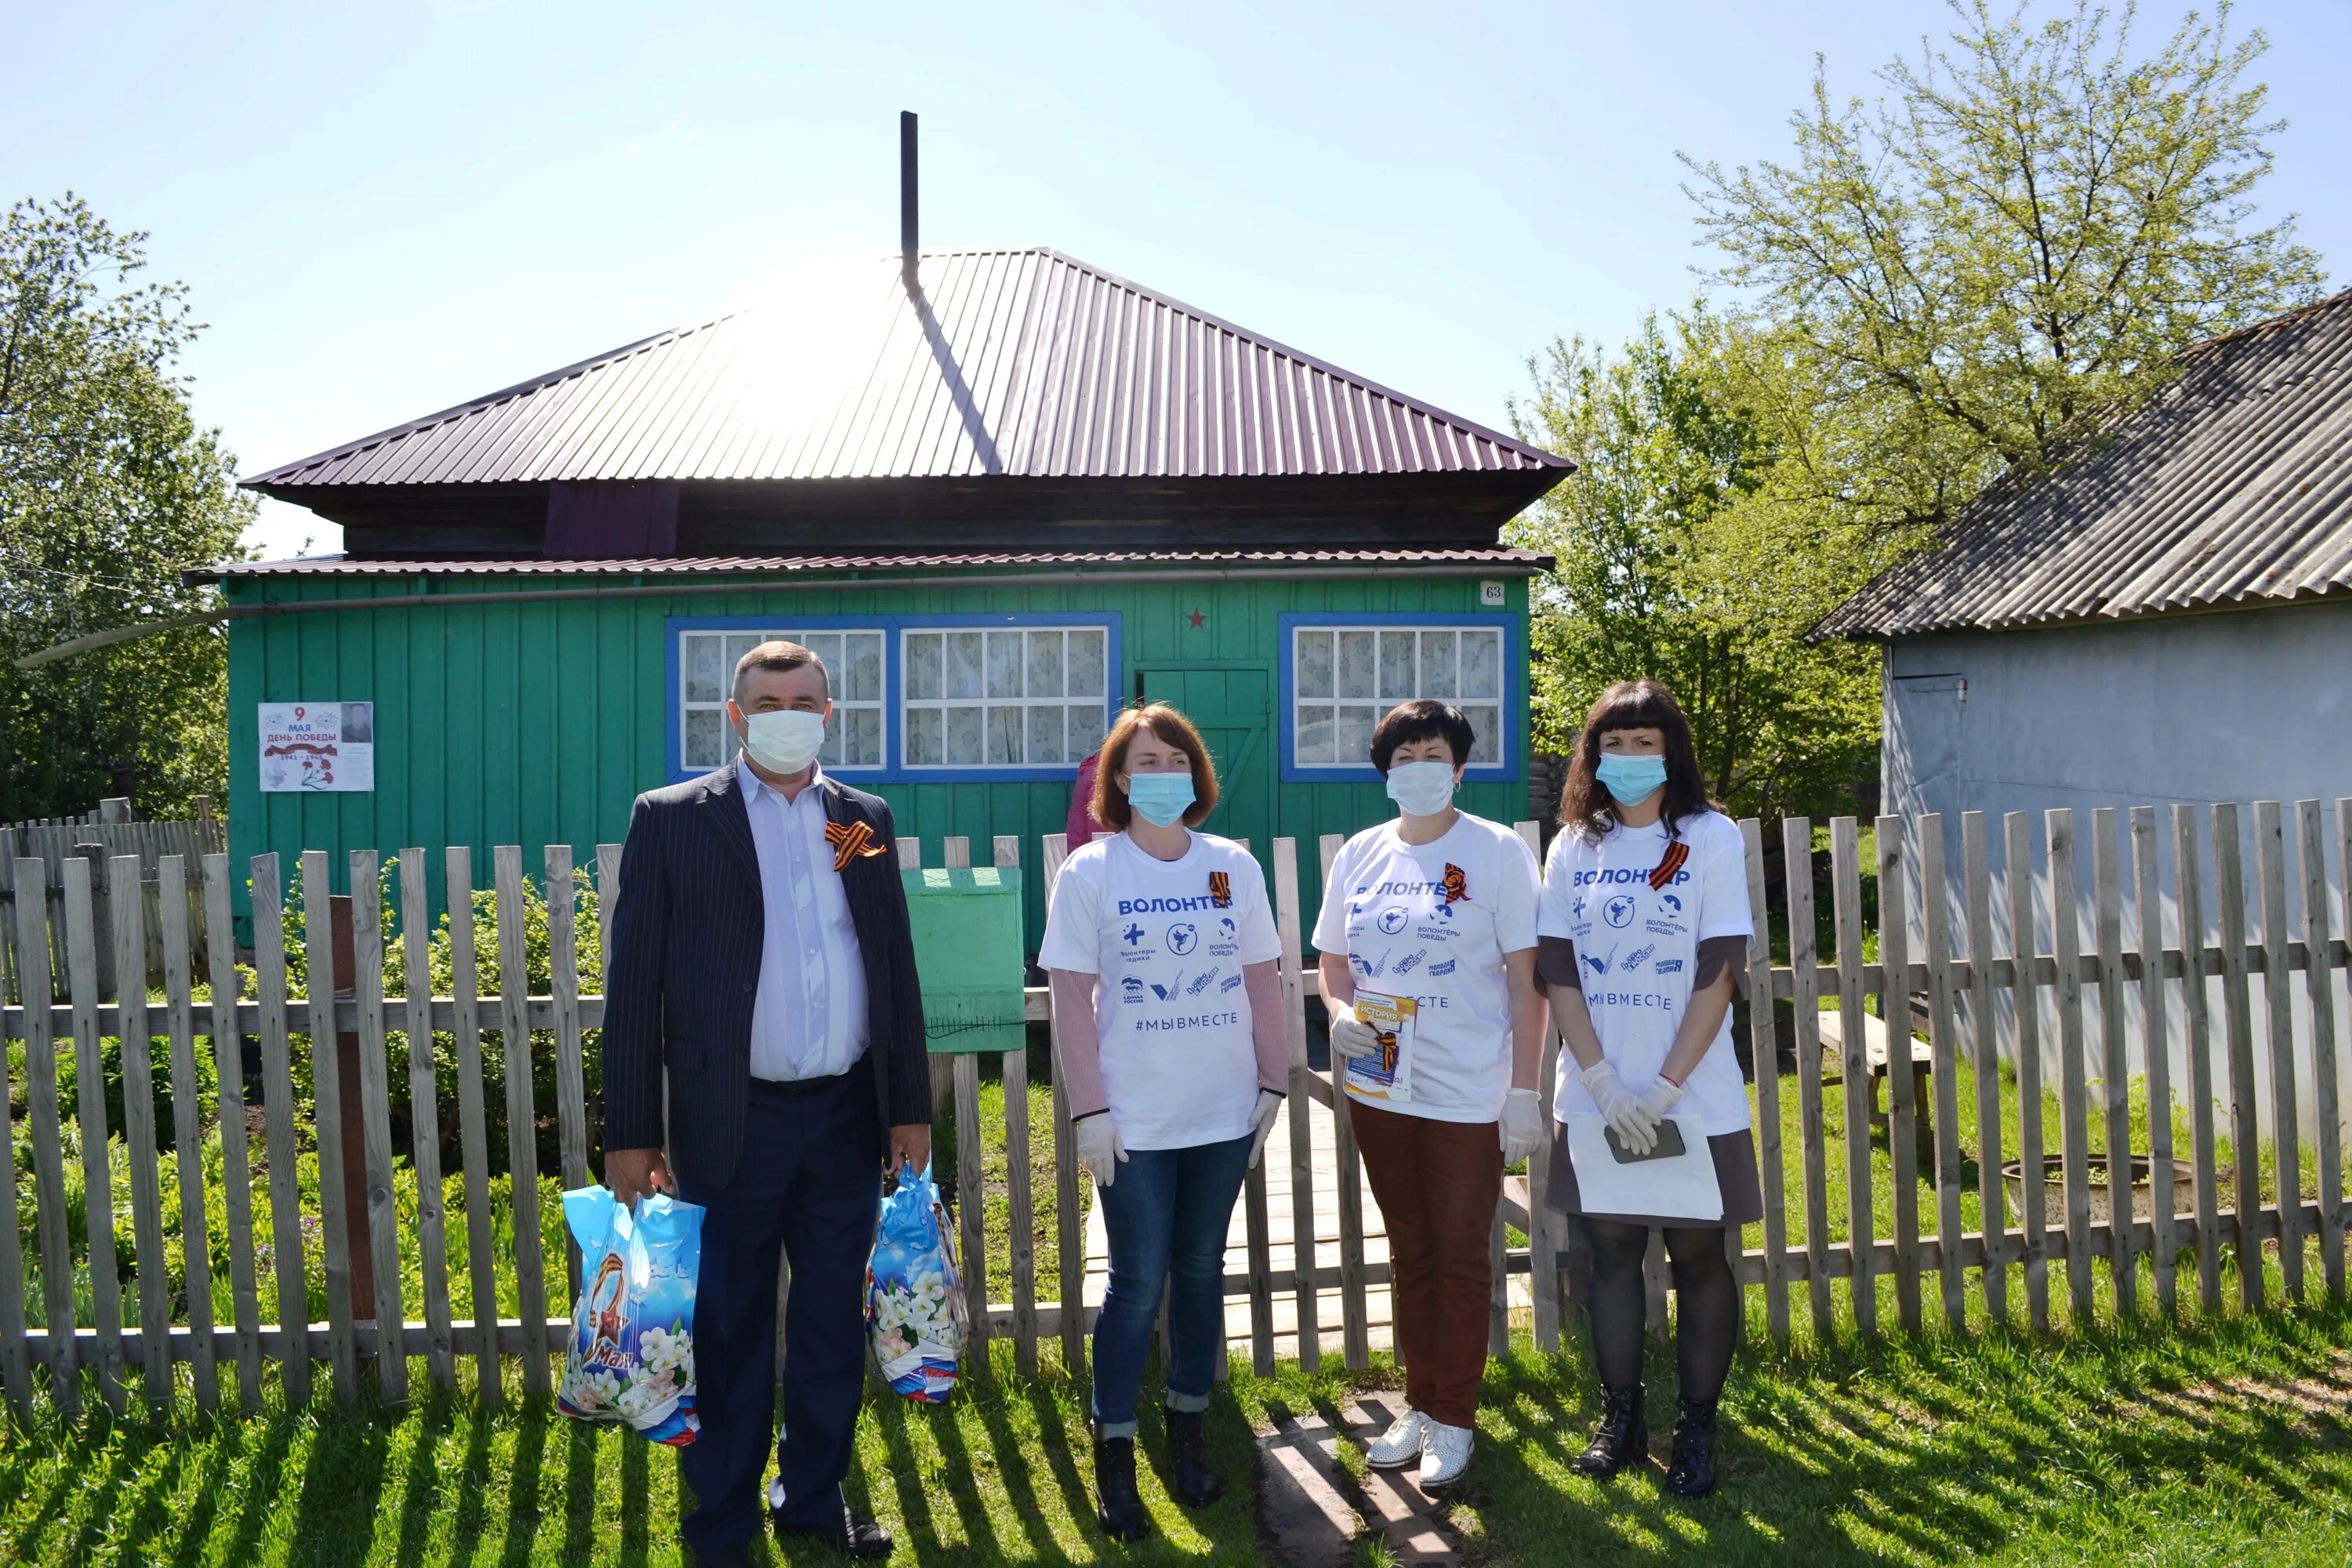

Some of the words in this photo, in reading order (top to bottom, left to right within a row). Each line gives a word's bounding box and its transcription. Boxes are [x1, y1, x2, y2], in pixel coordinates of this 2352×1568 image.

[1486, 586, 1501, 598] 63
[294, 706, 306, 722] 9
[288, 724, 311, 733] МАЯ
[267, 734, 292, 742] ДЕНЬ
[296, 733, 336, 742] ПОБЕДЫ
[1646, 926, 1674, 936] ПОБЕДЫ
[1360, 1005, 1398, 1021] ИСТОРИЯ
[1135, 1012, 1237, 1032] #МЫВМЕСТЕ
